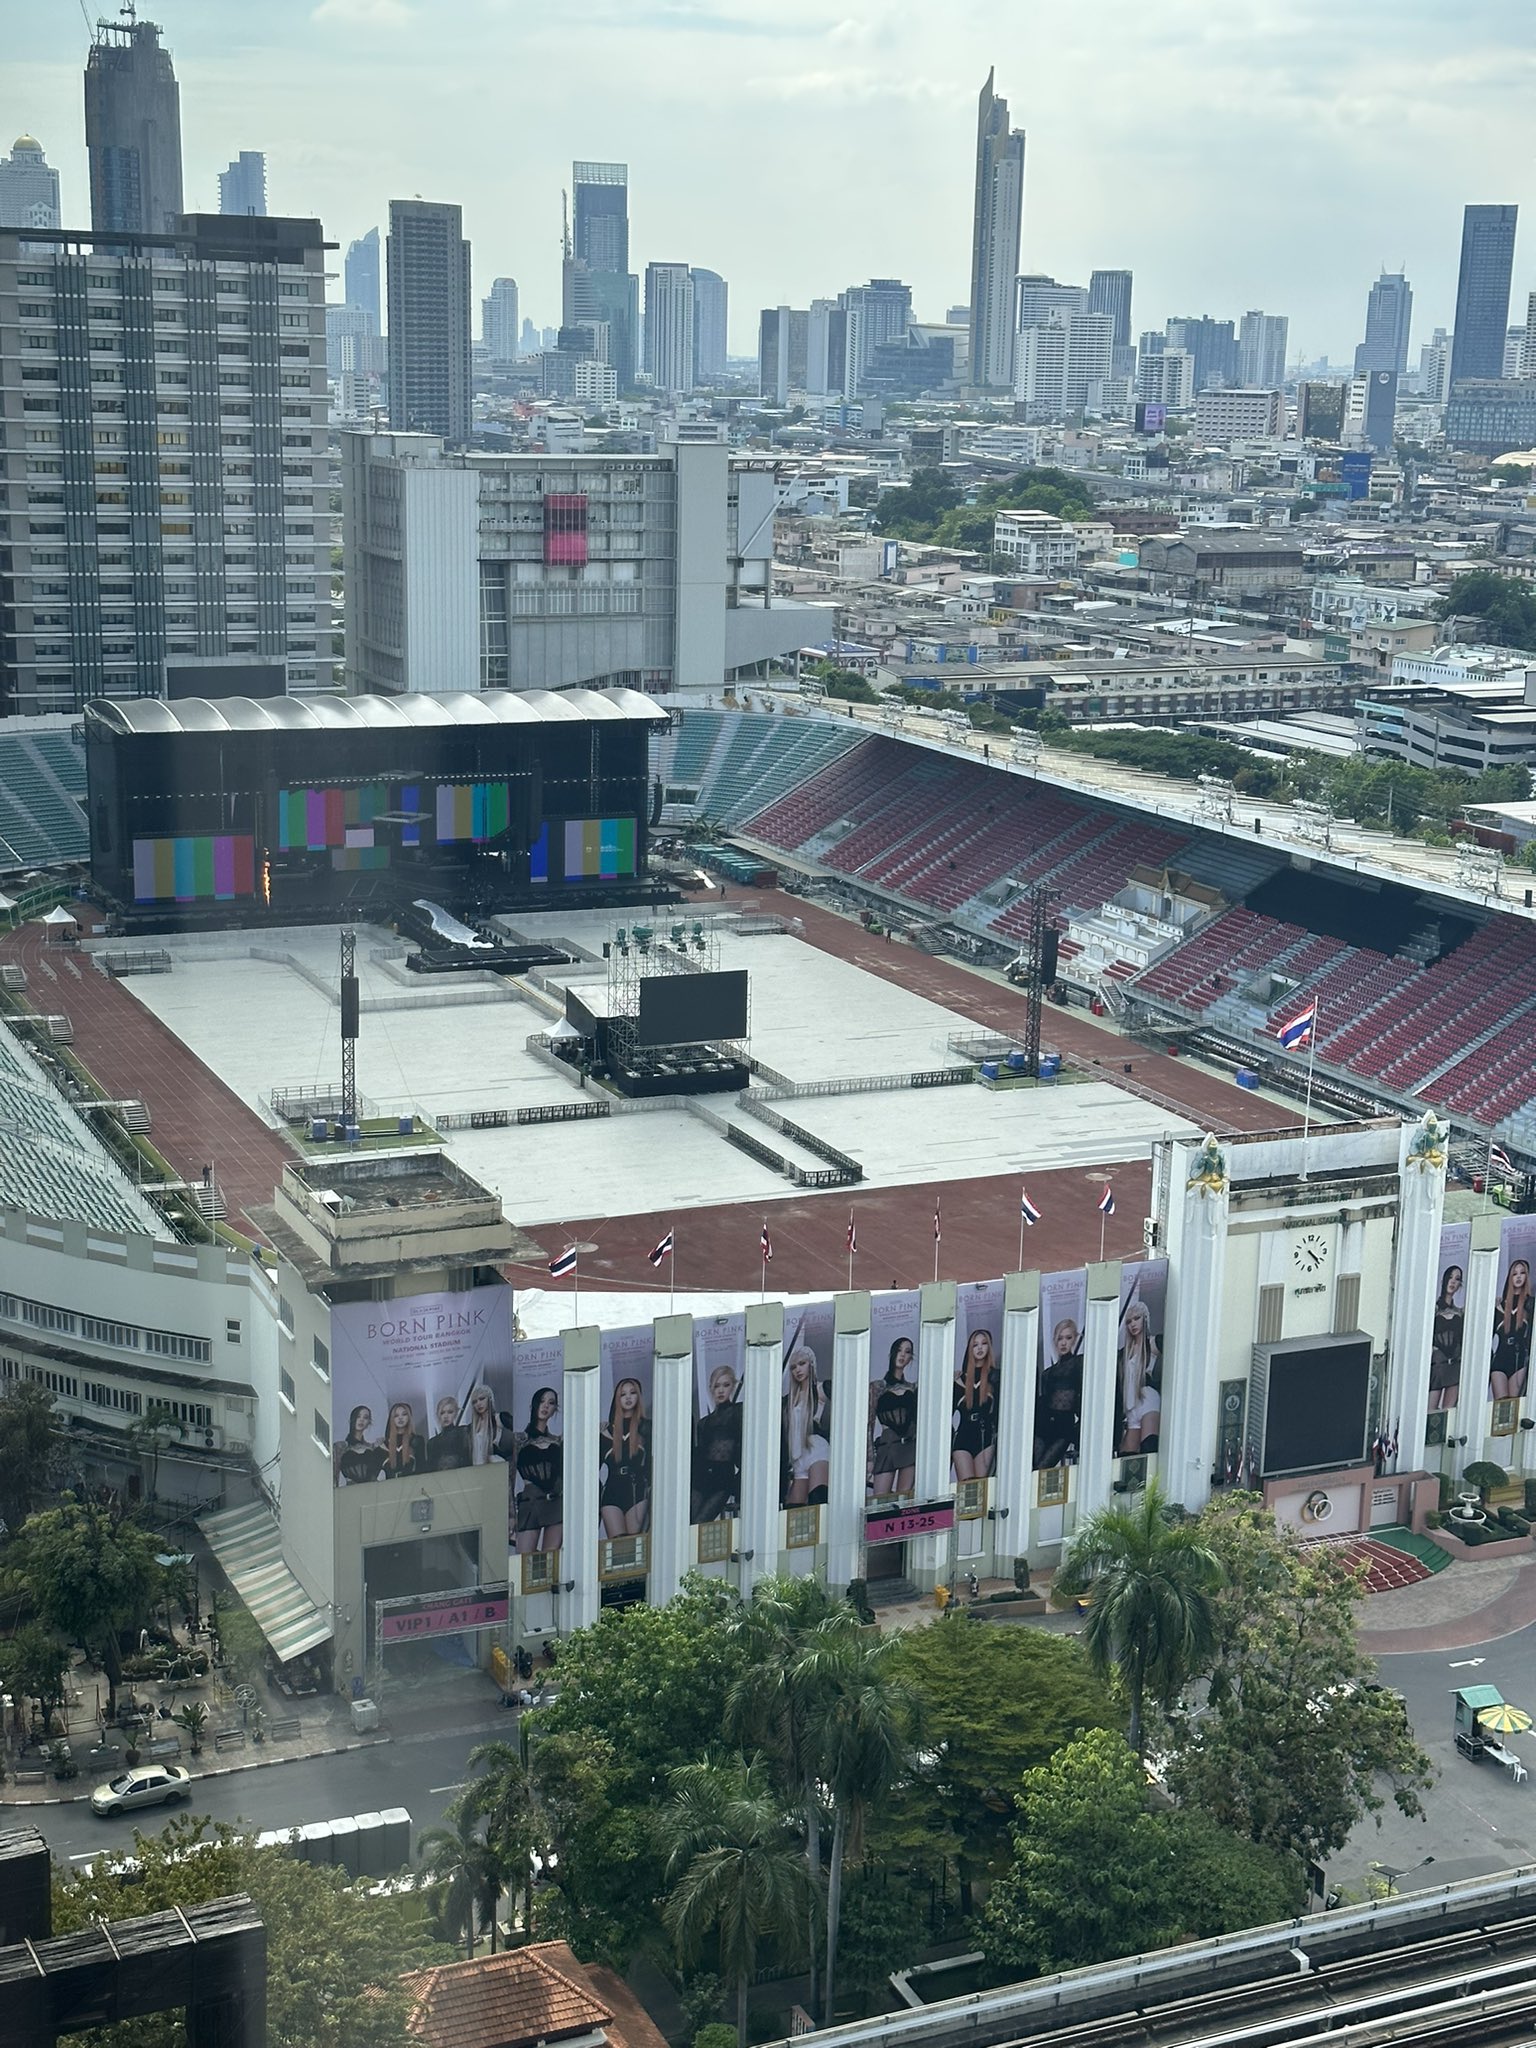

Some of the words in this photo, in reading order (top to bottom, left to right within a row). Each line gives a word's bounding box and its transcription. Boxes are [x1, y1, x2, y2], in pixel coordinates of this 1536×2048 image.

[1308, 1234, 1314, 1242] 12
[368, 1317, 426, 1339] BORN
[437, 1309, 486, 1330] PINK
[383, 1336, 410, 1345] WORLD
[413, 1332, 434, 1342] TOUR
[436, 1328, 471, 1339] BANGKOK
[392, 1344, 428, 1354] NATIONAL
[430, 1339, 461, 1350] STADIUM
[540, 1348, 562, 1359] PINK
[885, 1522, 894, 1532] N
[900, 1516, 935, 1530] 13-25
[396, 1616, 431, 1632] VIP1
[448, 1611, 468, 1624] A1
[484, 1606, 496, 1619] B
